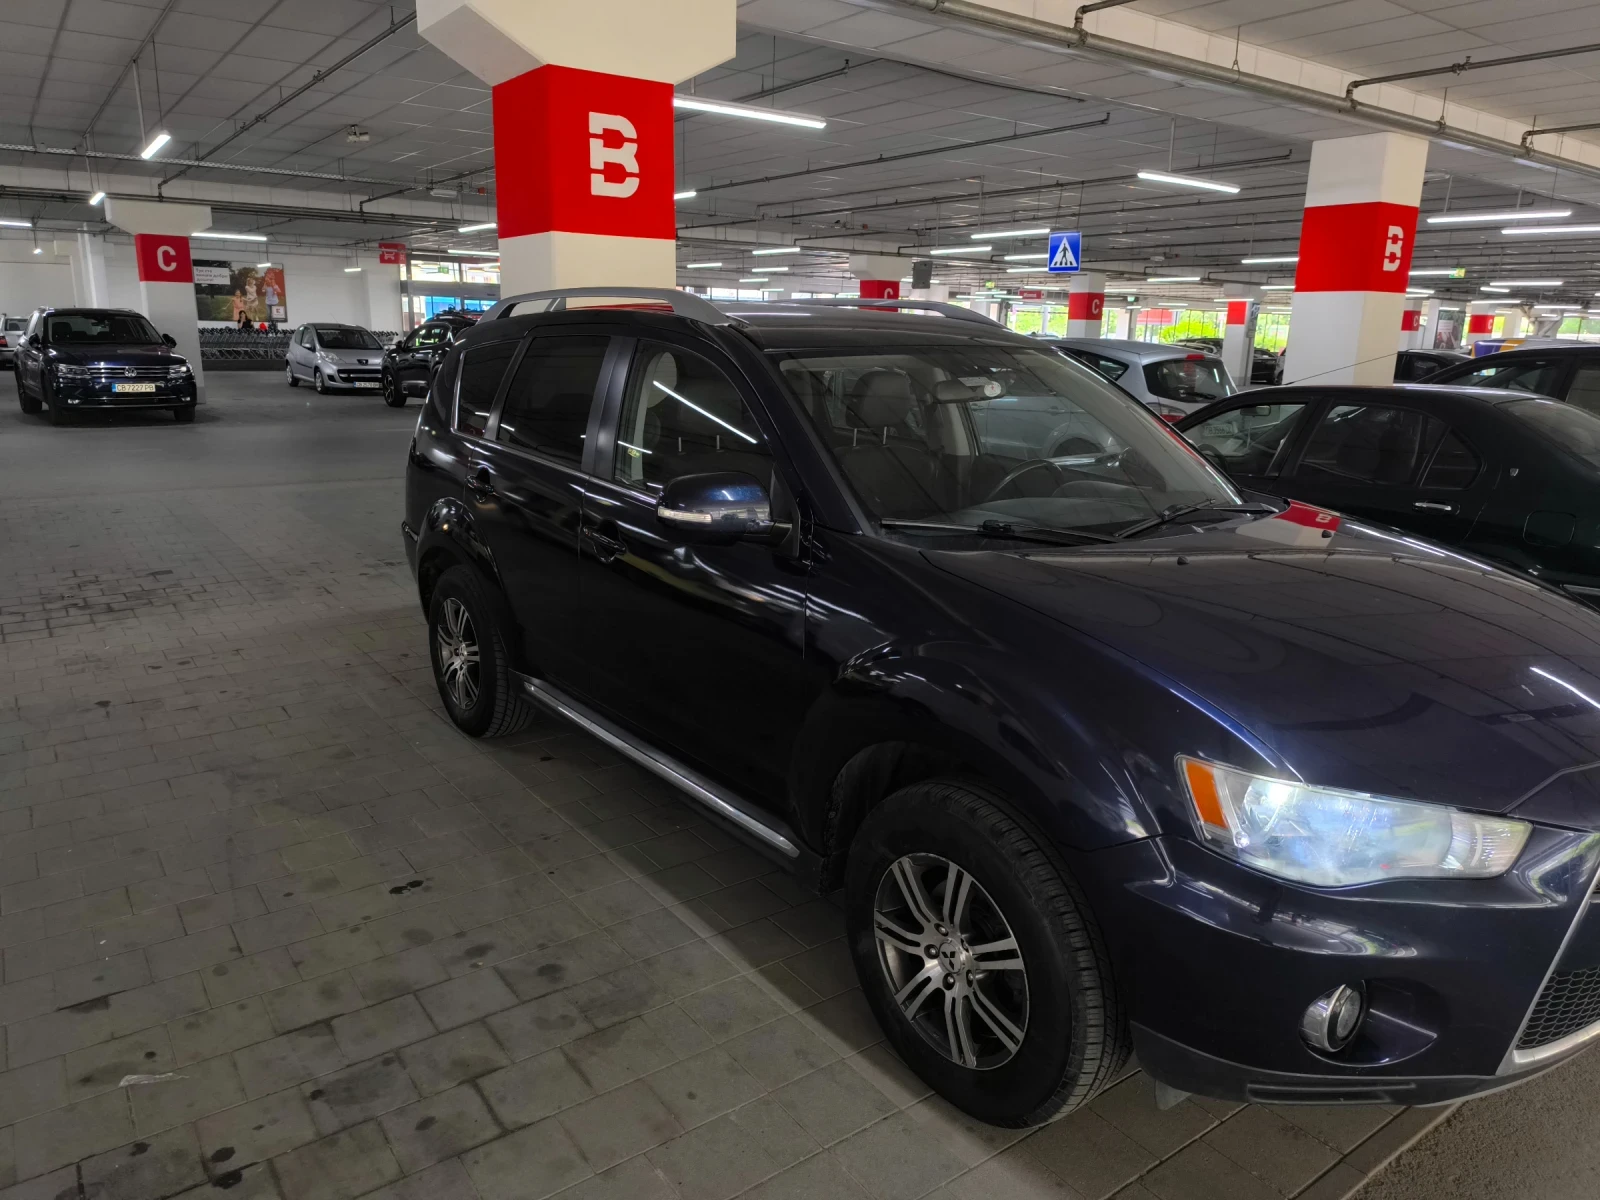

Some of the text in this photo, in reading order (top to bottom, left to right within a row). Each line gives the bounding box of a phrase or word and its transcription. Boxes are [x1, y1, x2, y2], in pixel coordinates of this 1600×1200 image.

[588, 111, 640, 198] B
[157, 245, 177, 272] C
[1382, 225, 1404, 272] B
[1092, 299, 1100, 314] C
[1413, 316, 1419, 327] C
